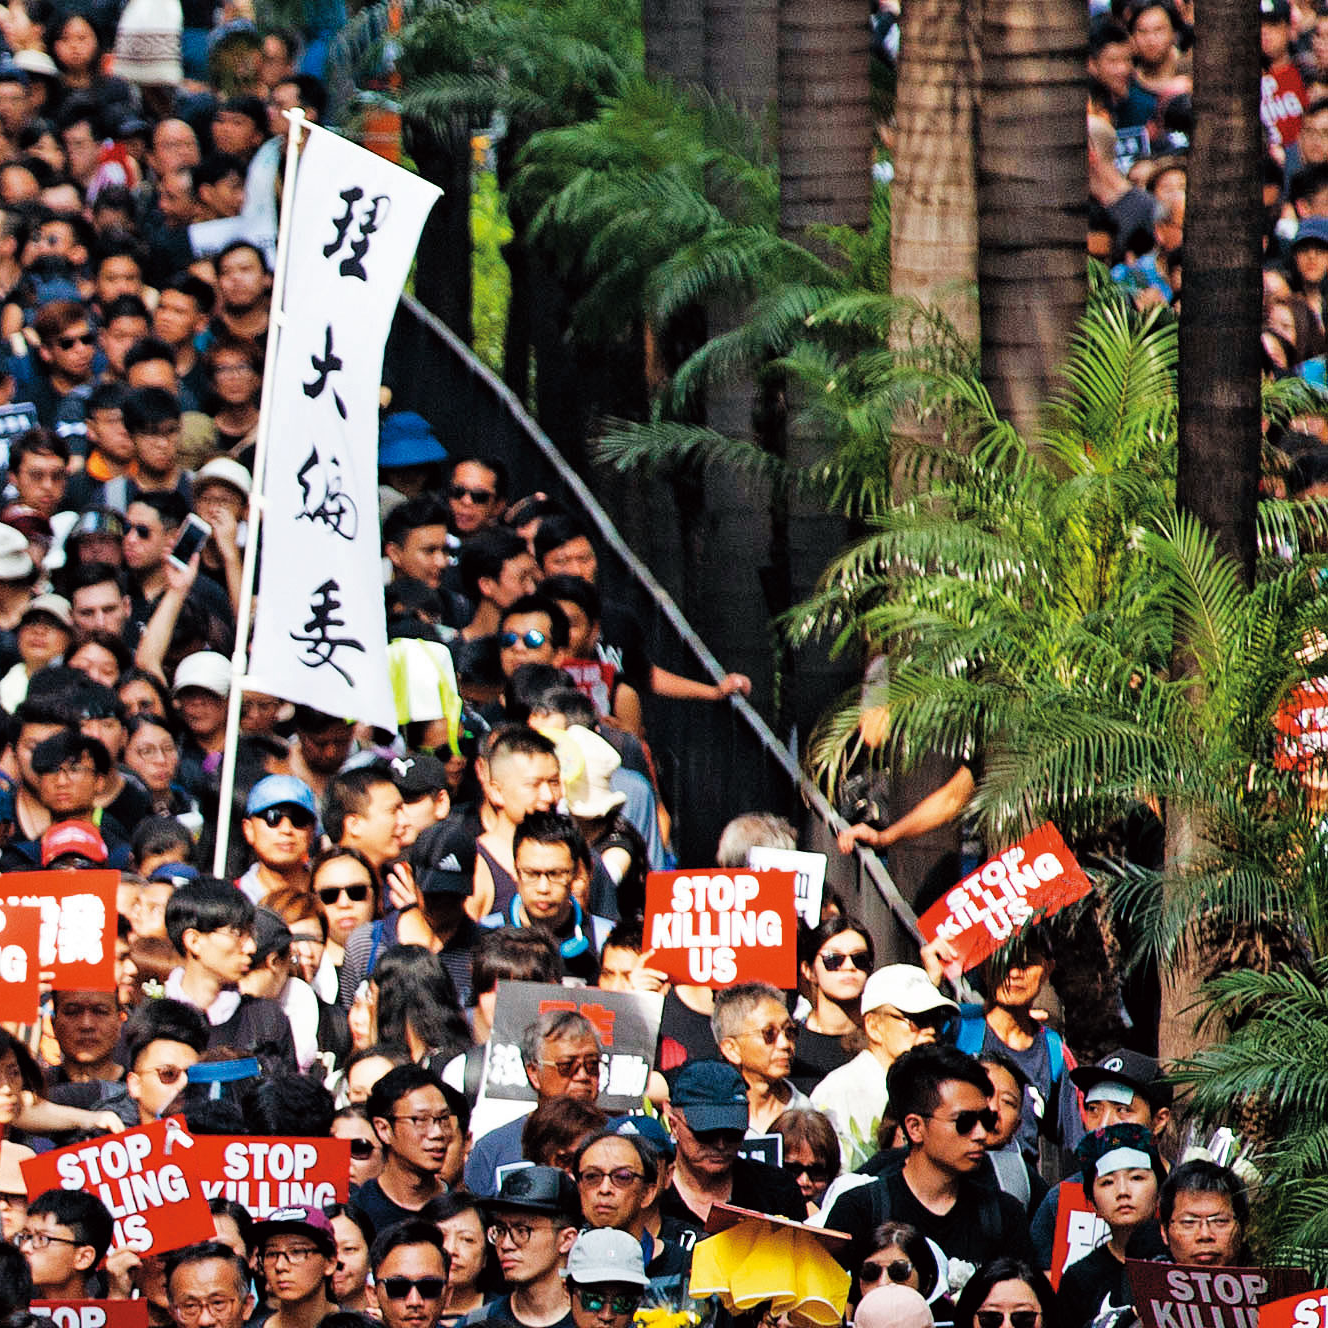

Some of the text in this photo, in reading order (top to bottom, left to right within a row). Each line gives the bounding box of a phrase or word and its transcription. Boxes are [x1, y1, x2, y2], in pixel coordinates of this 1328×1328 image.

[672, 875, 761, 912] STOP
[935, 853, 1067, 944] KILLING
[945, 847, 1026, 914] STOP
[652, 911, 783, 950] KILLING
[982, 900, 1035, 942] US
[689, 947, 737, 982] US
[1168, 1271, 1269, 1305] STOP
